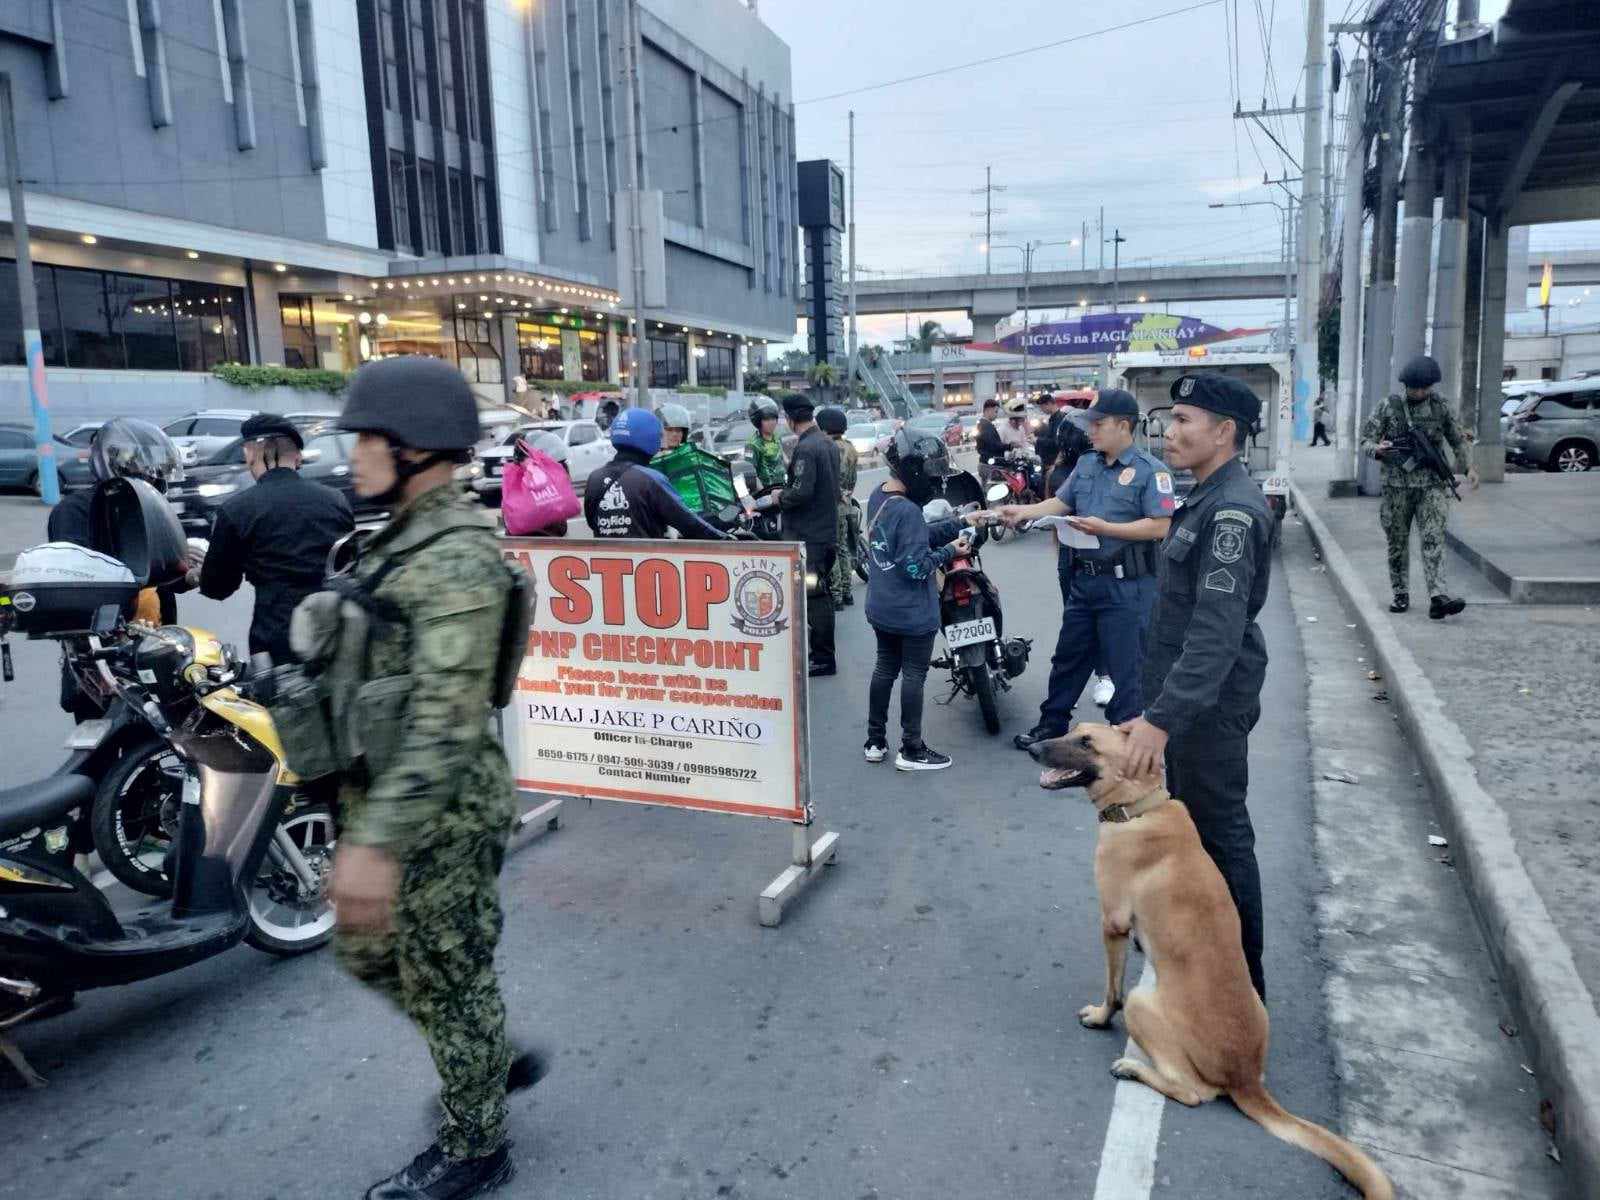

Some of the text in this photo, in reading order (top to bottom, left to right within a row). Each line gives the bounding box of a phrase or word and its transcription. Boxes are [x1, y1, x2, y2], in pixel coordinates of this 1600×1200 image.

[1020, 333, 1071, 346] LIGTAS
[1074, 335, 1088, 345] na
[733, 558, 784, 582] CAINTA
[548, 555, 730, 630] STOP
[743, 625, 777, 636] POLICE
[527, 630, 764, 671] PNP CHECKPOINT
[557, 666, 727, 691] Please bear with us
[512, 677, 782, 711] hank you for your cooperation
[528, 704, 761, 740] PMAJ JAKE P CARIÑO
[594, 731, 632, 744] Officer
[598, 766, 691, 784] Contact Number
